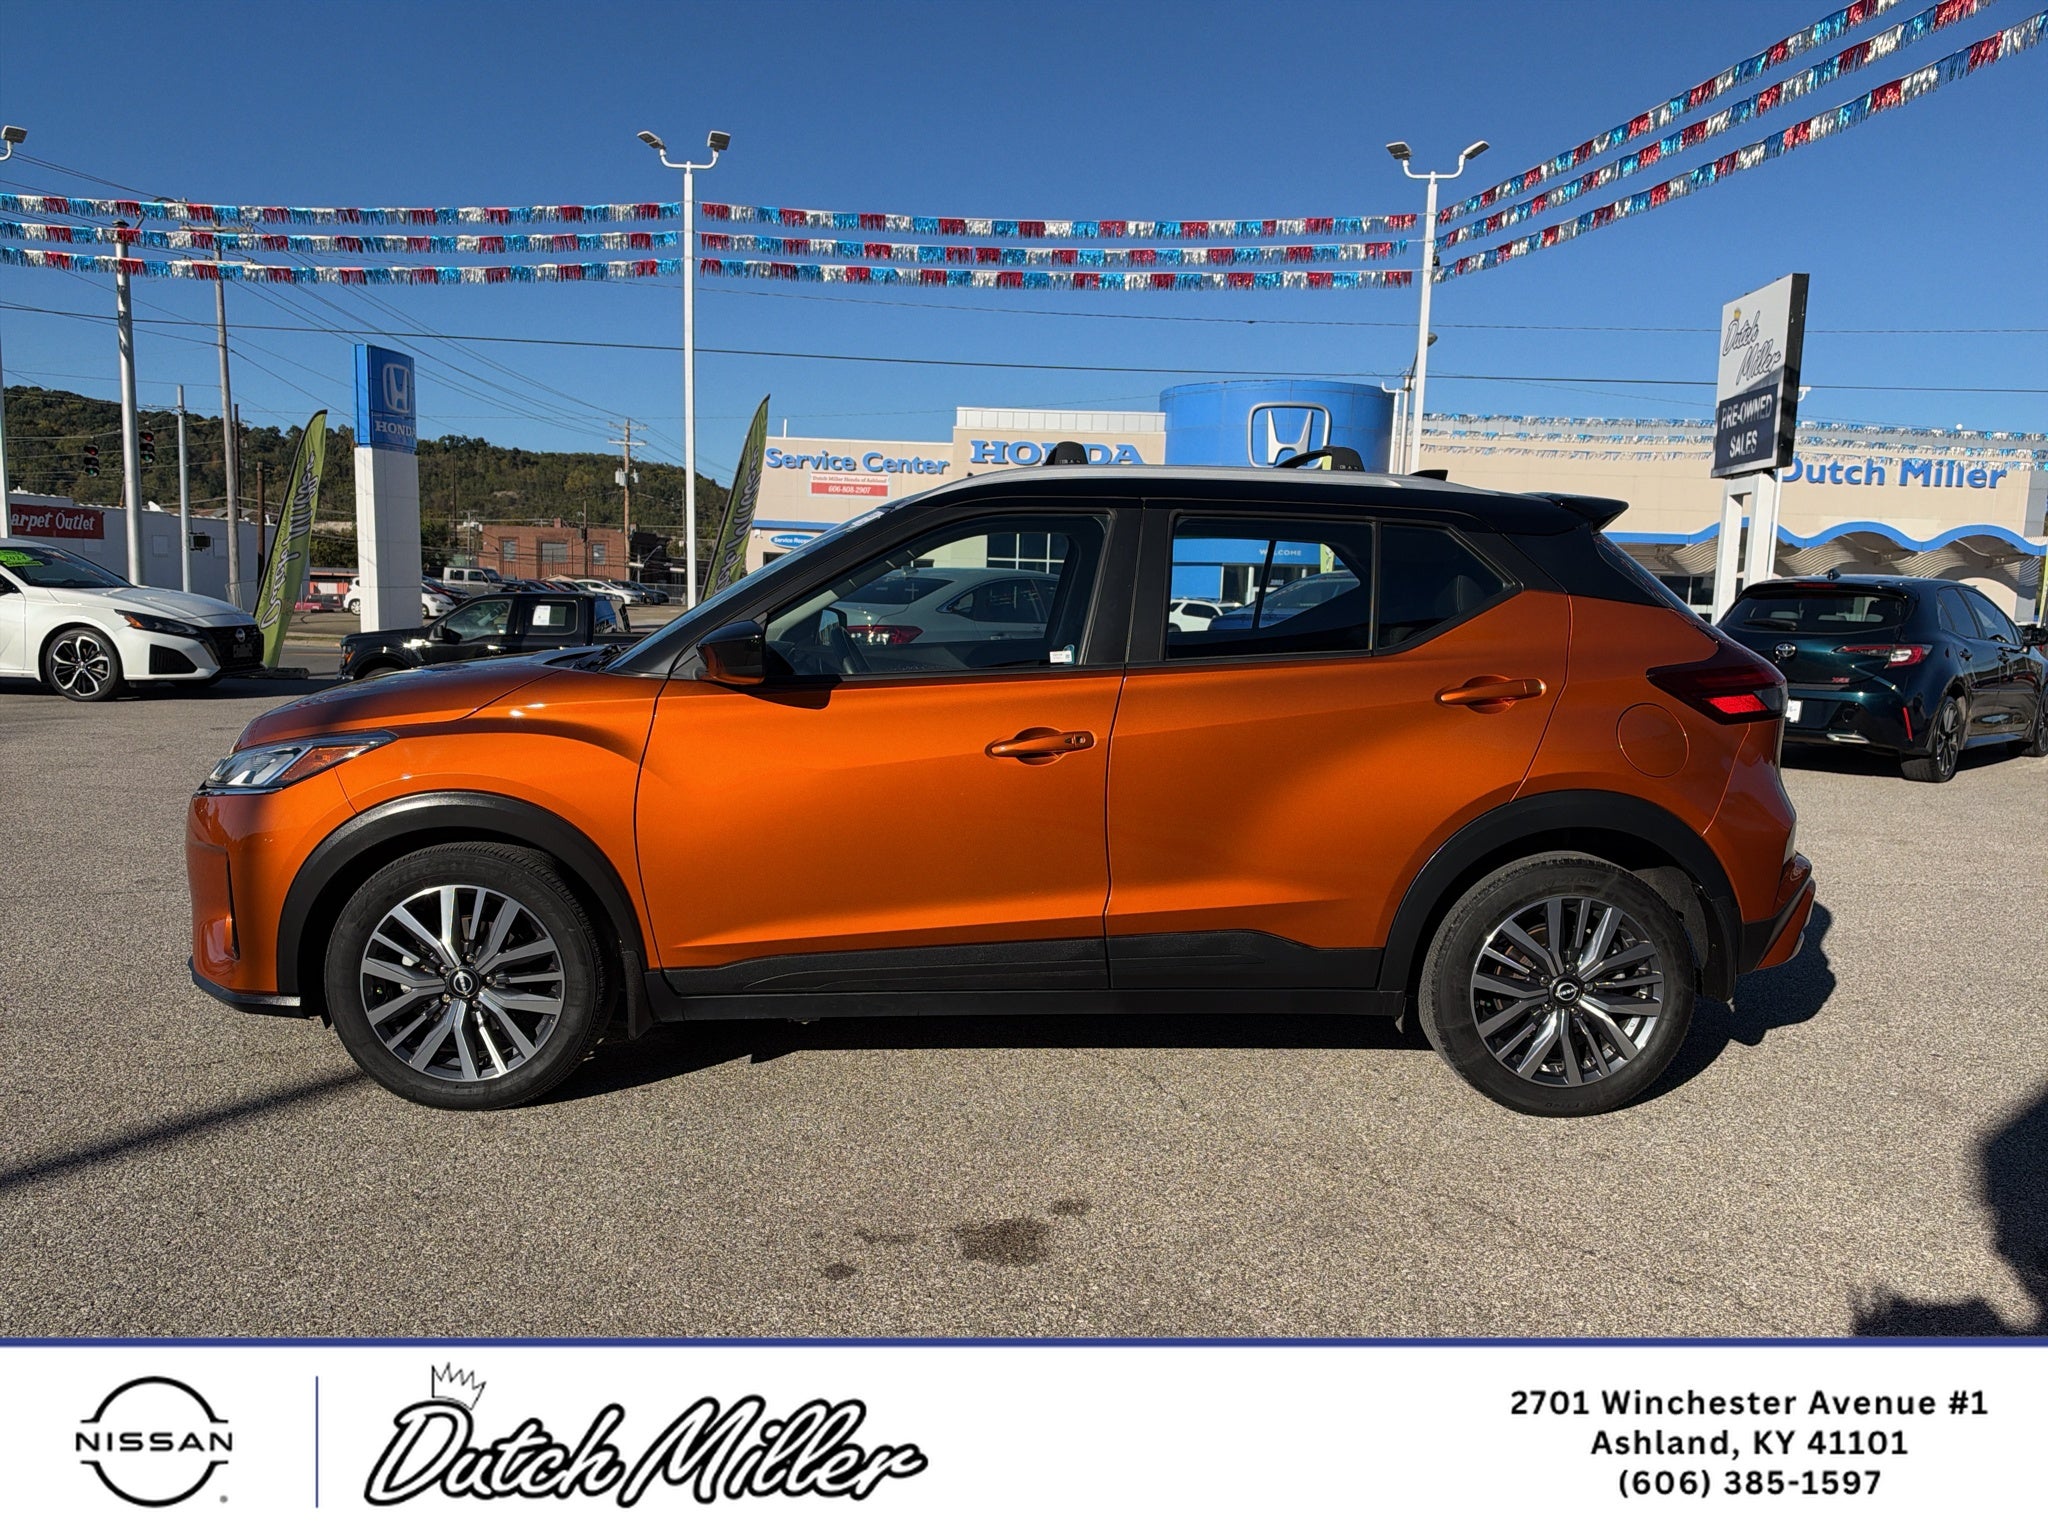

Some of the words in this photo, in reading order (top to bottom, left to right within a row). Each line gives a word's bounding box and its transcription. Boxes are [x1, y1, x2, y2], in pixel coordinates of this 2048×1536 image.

[1722, 310, 1760, 357] Dutch
[1736, 338, 1782, 386] Miller
[1721, 394, 1773, 431] PRE-OWNED
[970, 440, 1147, 466] HODA
[1729, 430, 1758, 459] SALES
[765, 447, 856, 472] Service
[862, 451, 950, 475] Center
[1898, 458, 2008, 489] Miller
[11, 512, 52, 532] arpet
[55, 510, 96, 531] Outlet
[1259, 548, 1302, 556] WLCOME
